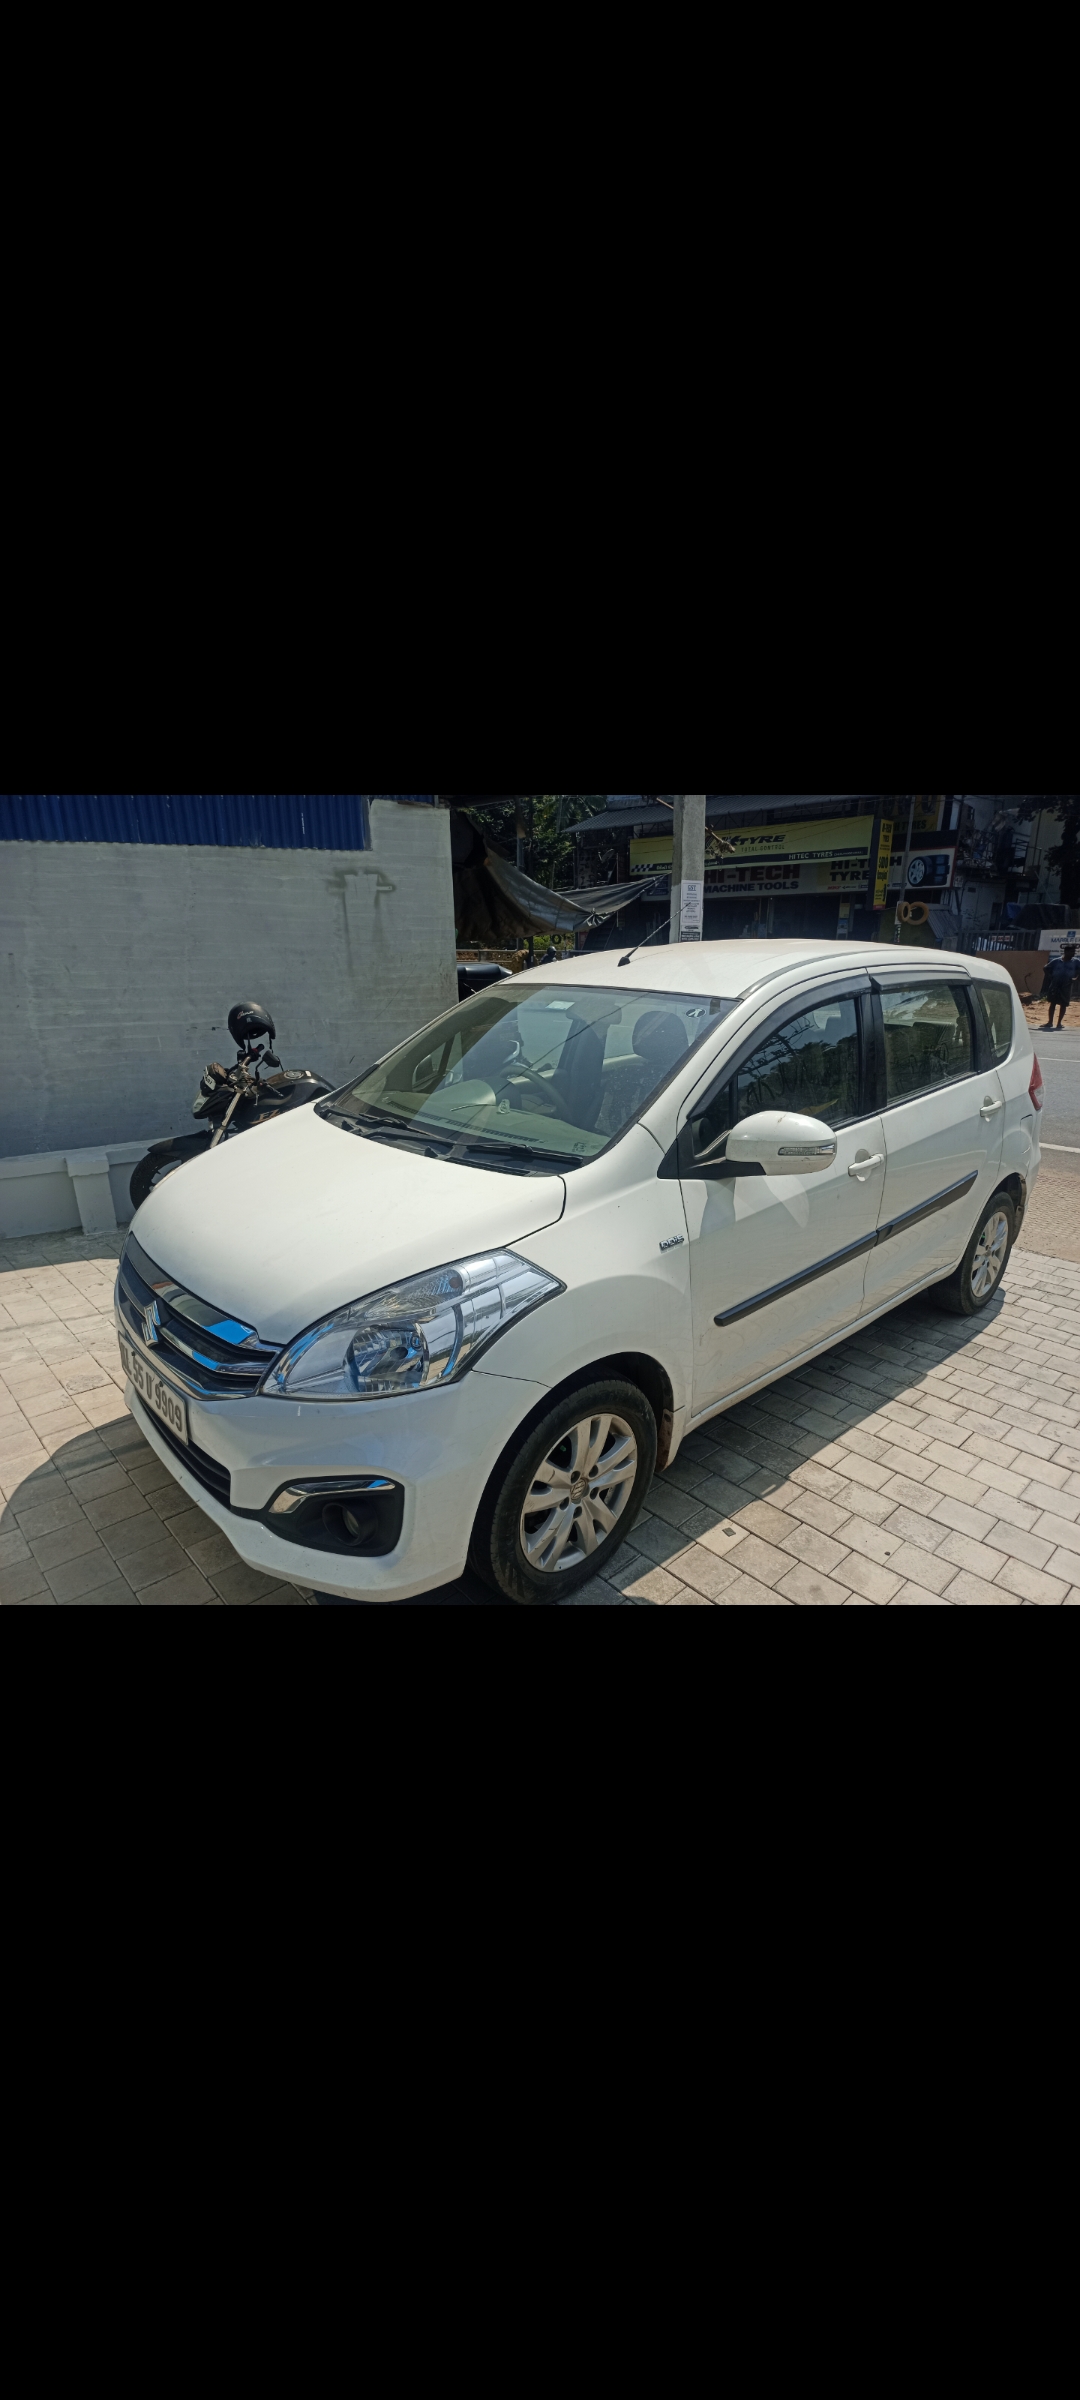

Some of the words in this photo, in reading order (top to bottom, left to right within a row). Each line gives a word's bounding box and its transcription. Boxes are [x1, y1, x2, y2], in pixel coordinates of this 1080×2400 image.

[902, 820, 927, 831] TRES
[704, 864, 800, 883] HI-TECH
[829, 870, 870, 882] TYRE
[704, 883, 755, 894] MACHINE
[757, 881, 799, 891] TOOLS
[154, 1382, 183, 1433] 9909
